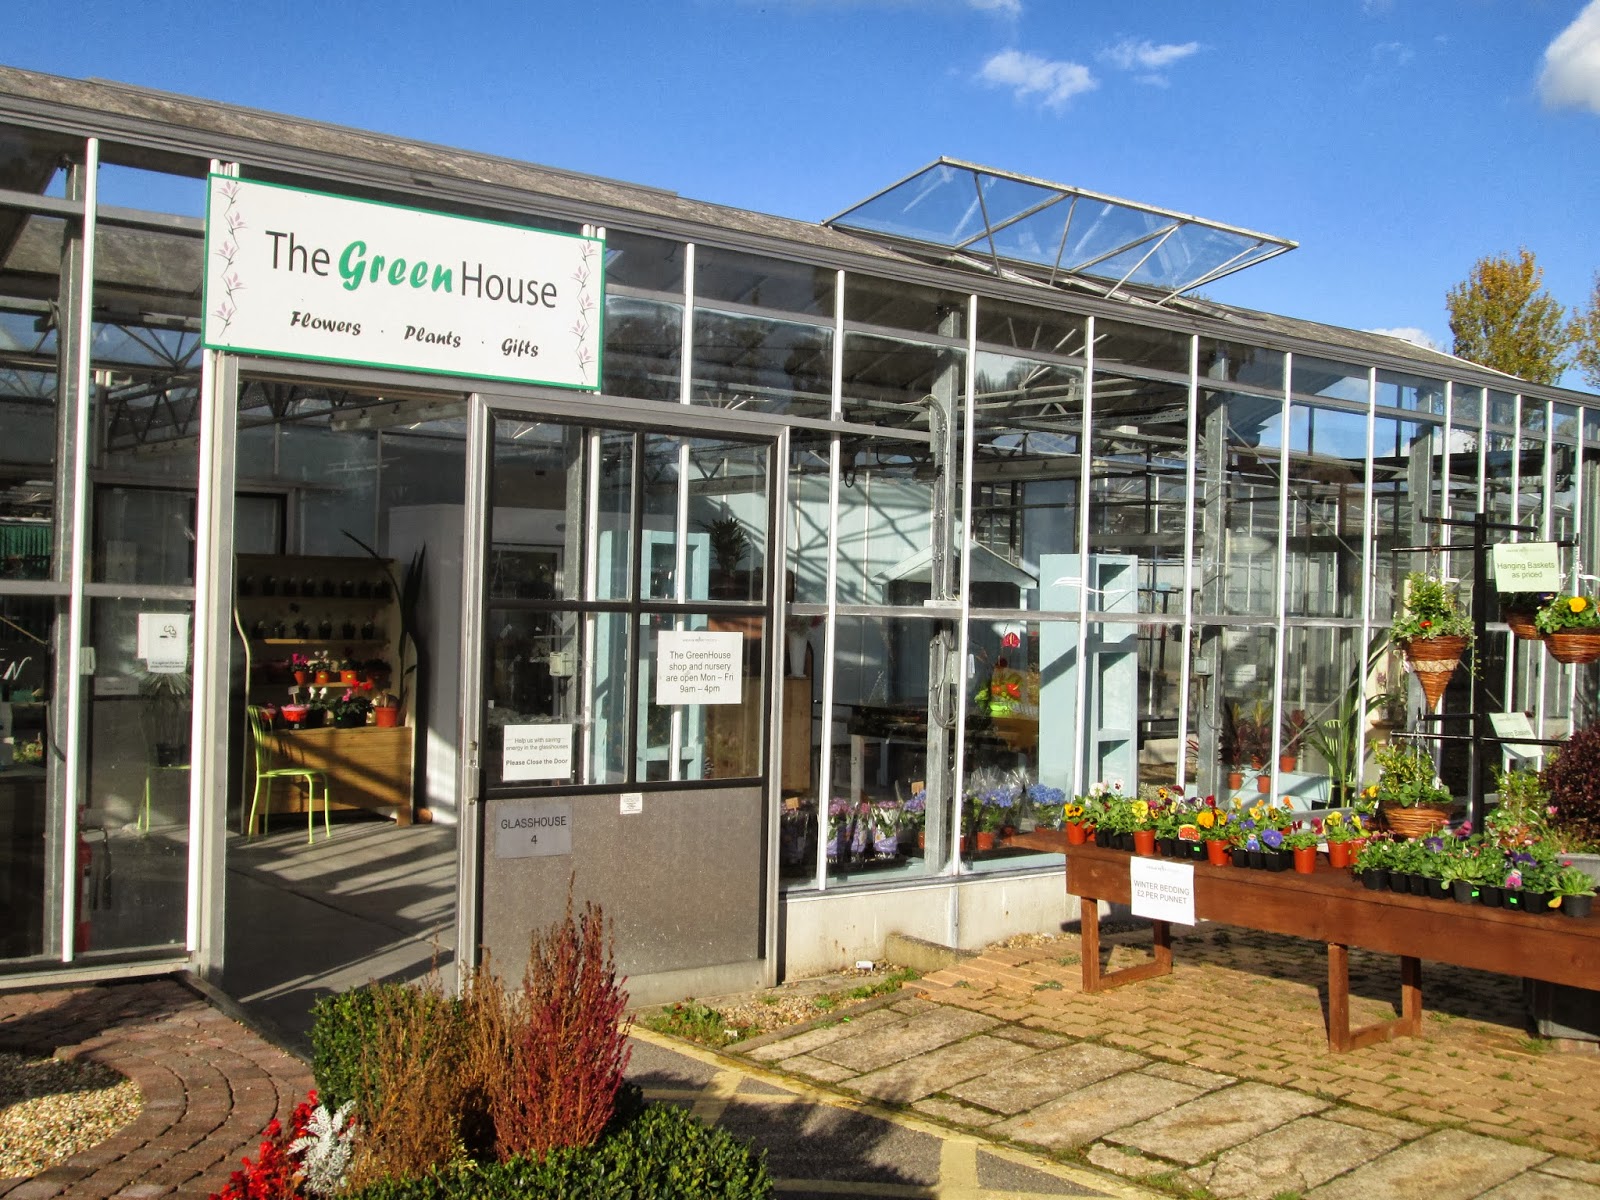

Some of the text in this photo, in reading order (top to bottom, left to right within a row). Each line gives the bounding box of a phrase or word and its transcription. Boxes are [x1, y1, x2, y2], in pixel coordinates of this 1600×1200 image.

[265, 230, 558, 308] The Green House
[290, 310, 540, 357] Flowers Plants Gifts
[1497, 561, 1555, 570] Hanging Baskets
[1522, 571, 1543, 579] priced
[670, 651, 732, 660] The GreenHouse
[669, 663, 732, 672] shop and nursery
[679, 675, 698, 683] open
[700, 673, 716, 681] Mon
[724, 672, 734, 681] Fri
[680, 685, 696, 693] 9am
[704, 684, 720, 694] 4pm
[500, 815, 567, 829] GLASSHOUSE
[530, 834, 538, 845] 4
[1133, 879, 1190, 896] WINTER BEDDING
[1137, 889, 1188, 904] £2 PER PUNNET
